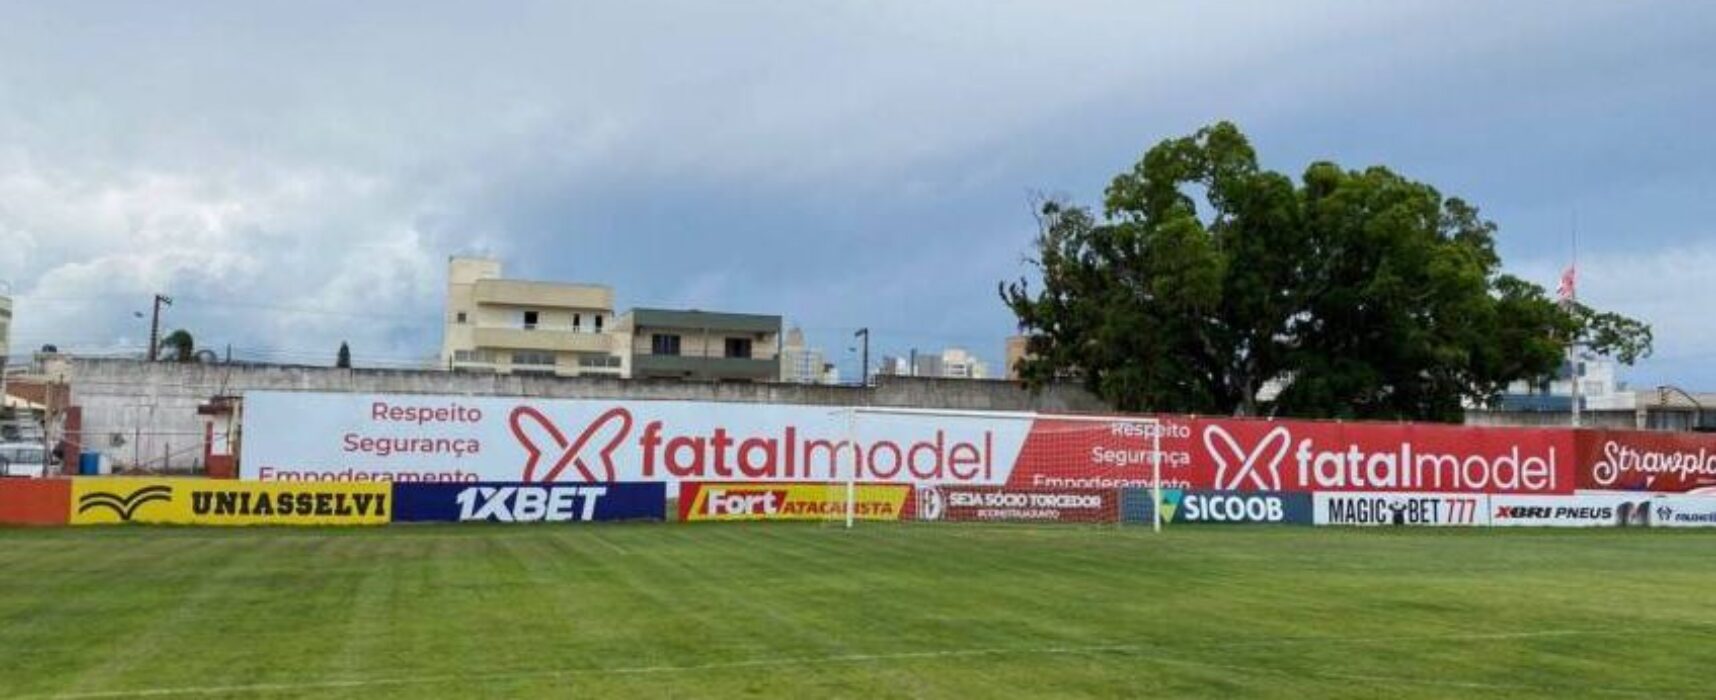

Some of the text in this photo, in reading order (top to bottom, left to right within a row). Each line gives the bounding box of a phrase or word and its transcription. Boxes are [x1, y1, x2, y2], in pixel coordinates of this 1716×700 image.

[372, 402, 482, 424] Respeito
[343, 433, 480, 457] Segurança
[640, 420, 993, 481] fatalmodel
[1296, 438, 1555, 490] fatalmodel
[191, 491, 386, 517] UNIASSELVI
[456, 486, 607, 522] 1XBET
[708, 488, 777, 515] Fort
[1184, 494, 1284, 521] SICOOB
[1328, 498, 1477, 523] MAGIC BET 777
[1555, 506, 1612, 519] PNEUS
